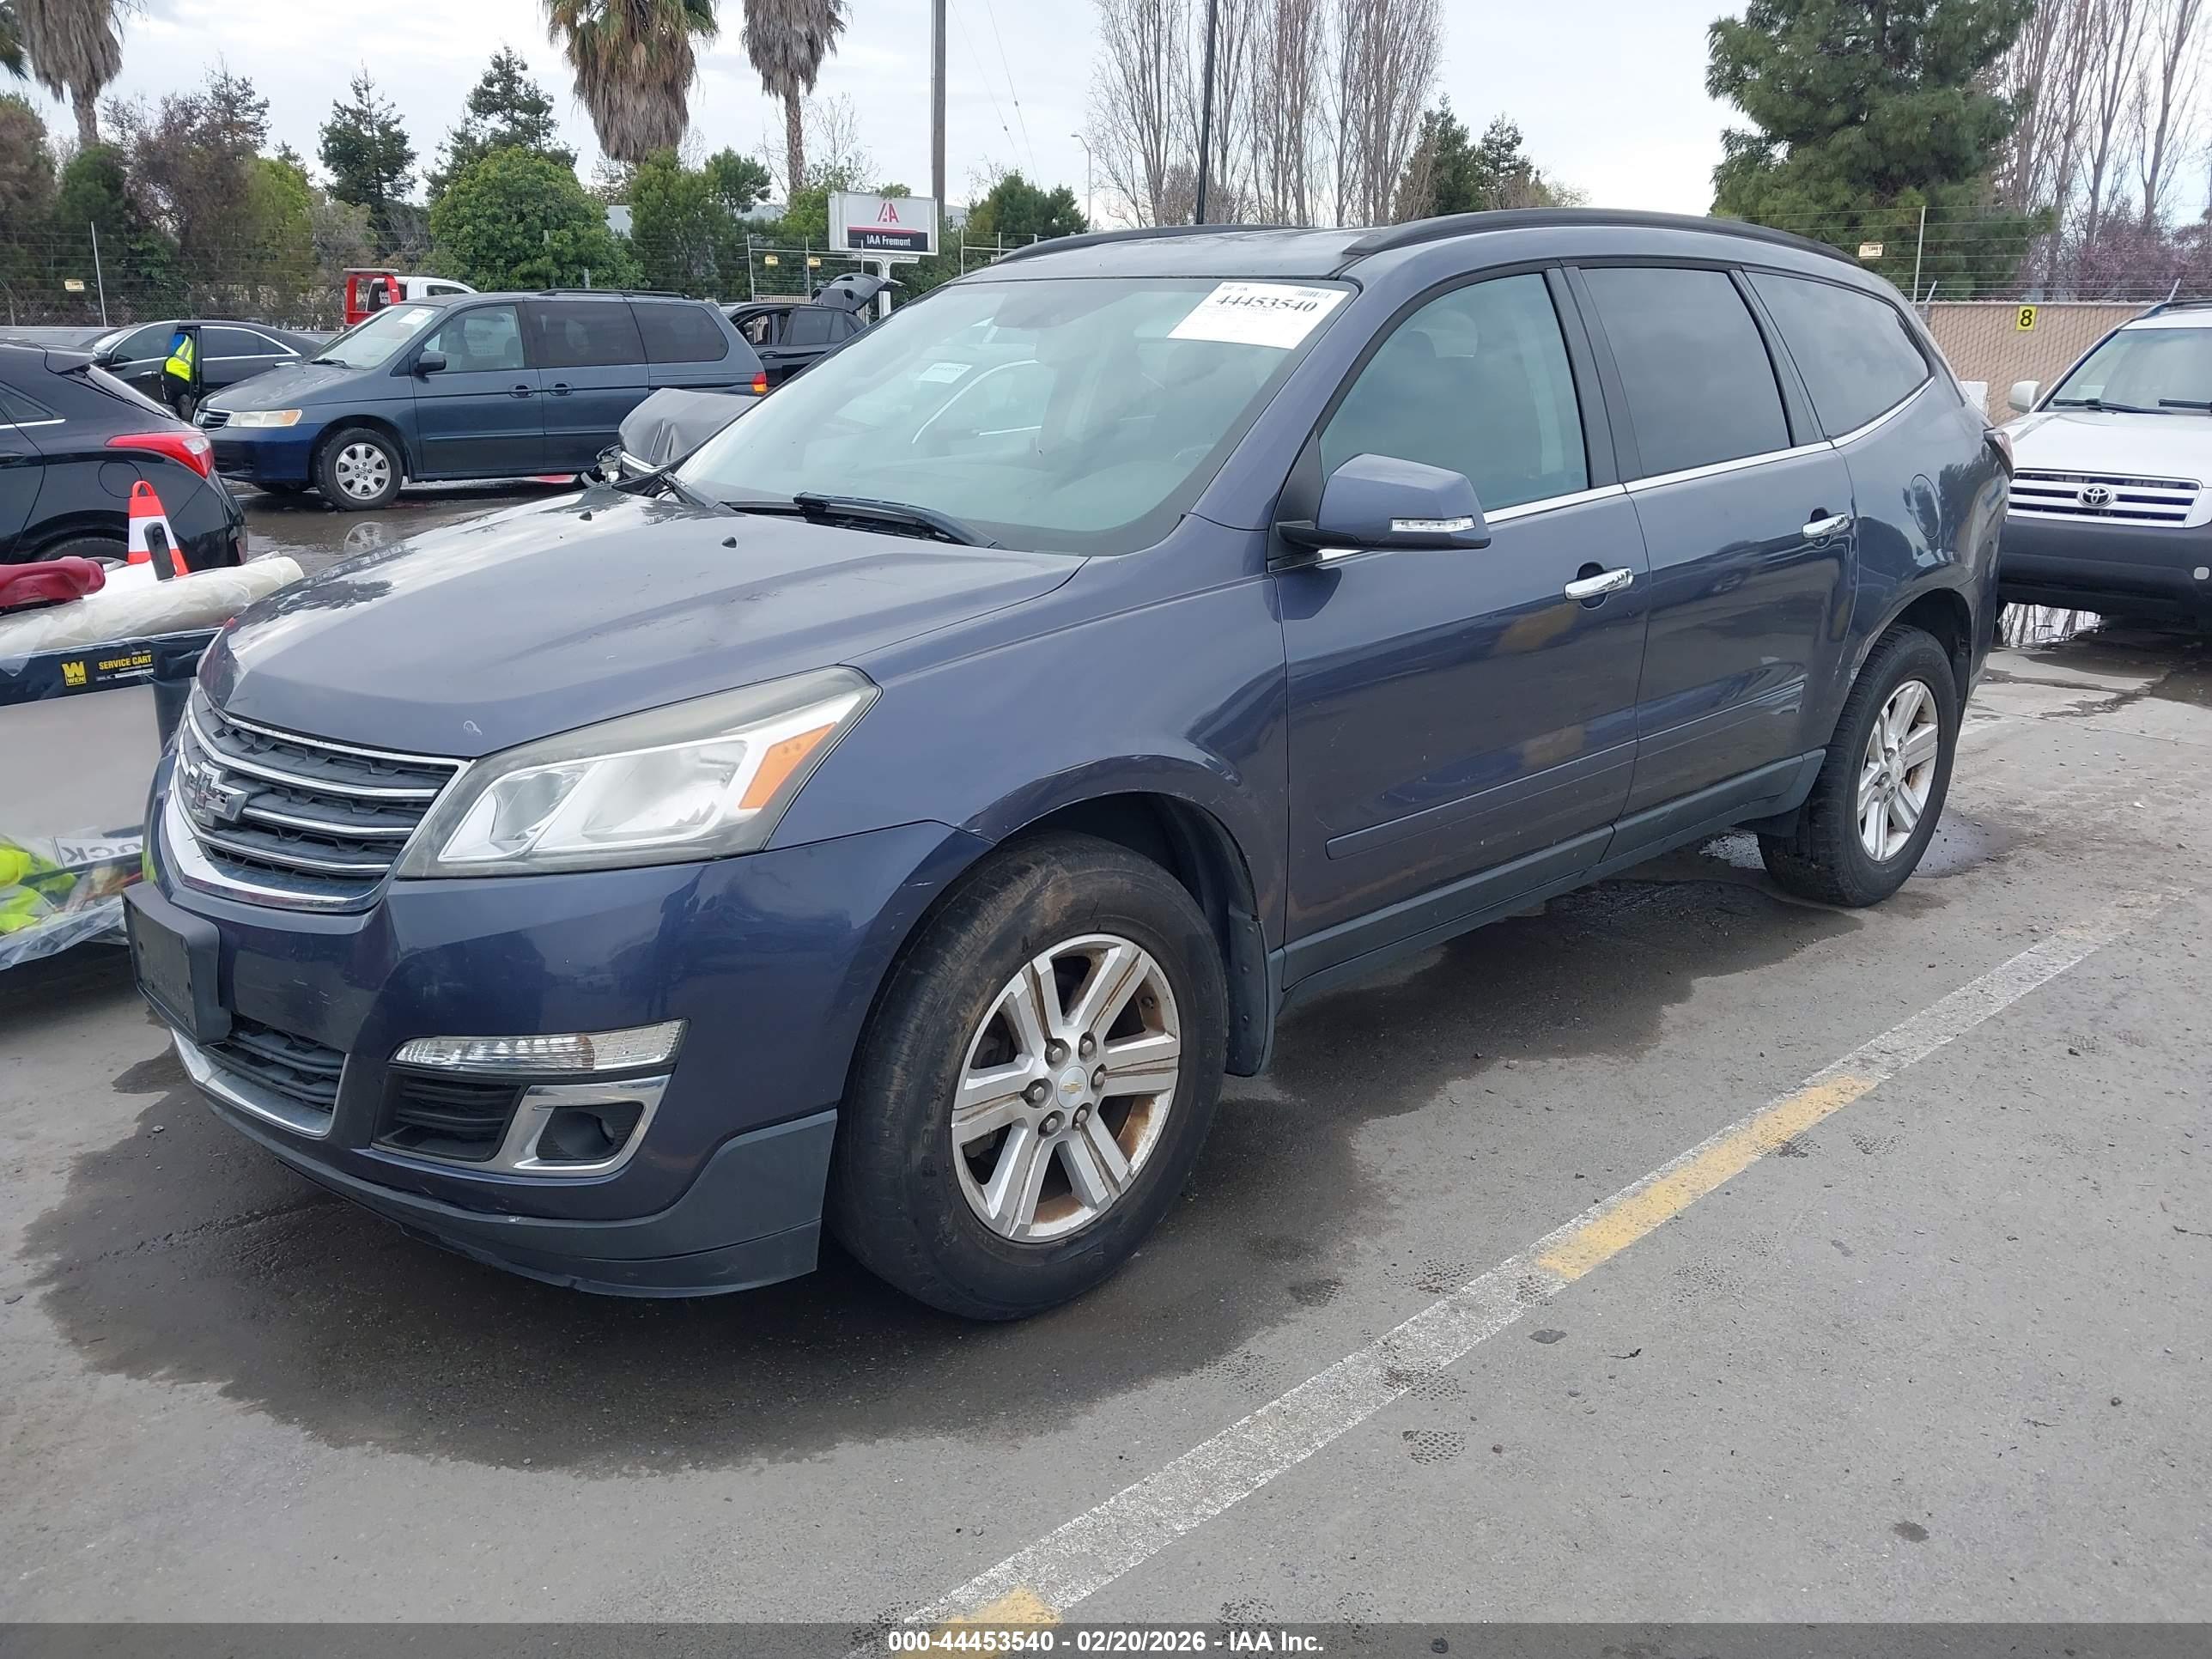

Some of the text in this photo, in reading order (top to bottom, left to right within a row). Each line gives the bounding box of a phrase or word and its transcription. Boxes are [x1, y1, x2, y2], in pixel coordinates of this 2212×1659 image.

[866, 234, 911, 246] IAA Fremont
[1215, 295, 1319, 313] 44453540
[2019, 308, 2033, 327] 8
[98, 658, 131, 671] SERVICE
[131, 654, 152, 665] CART
